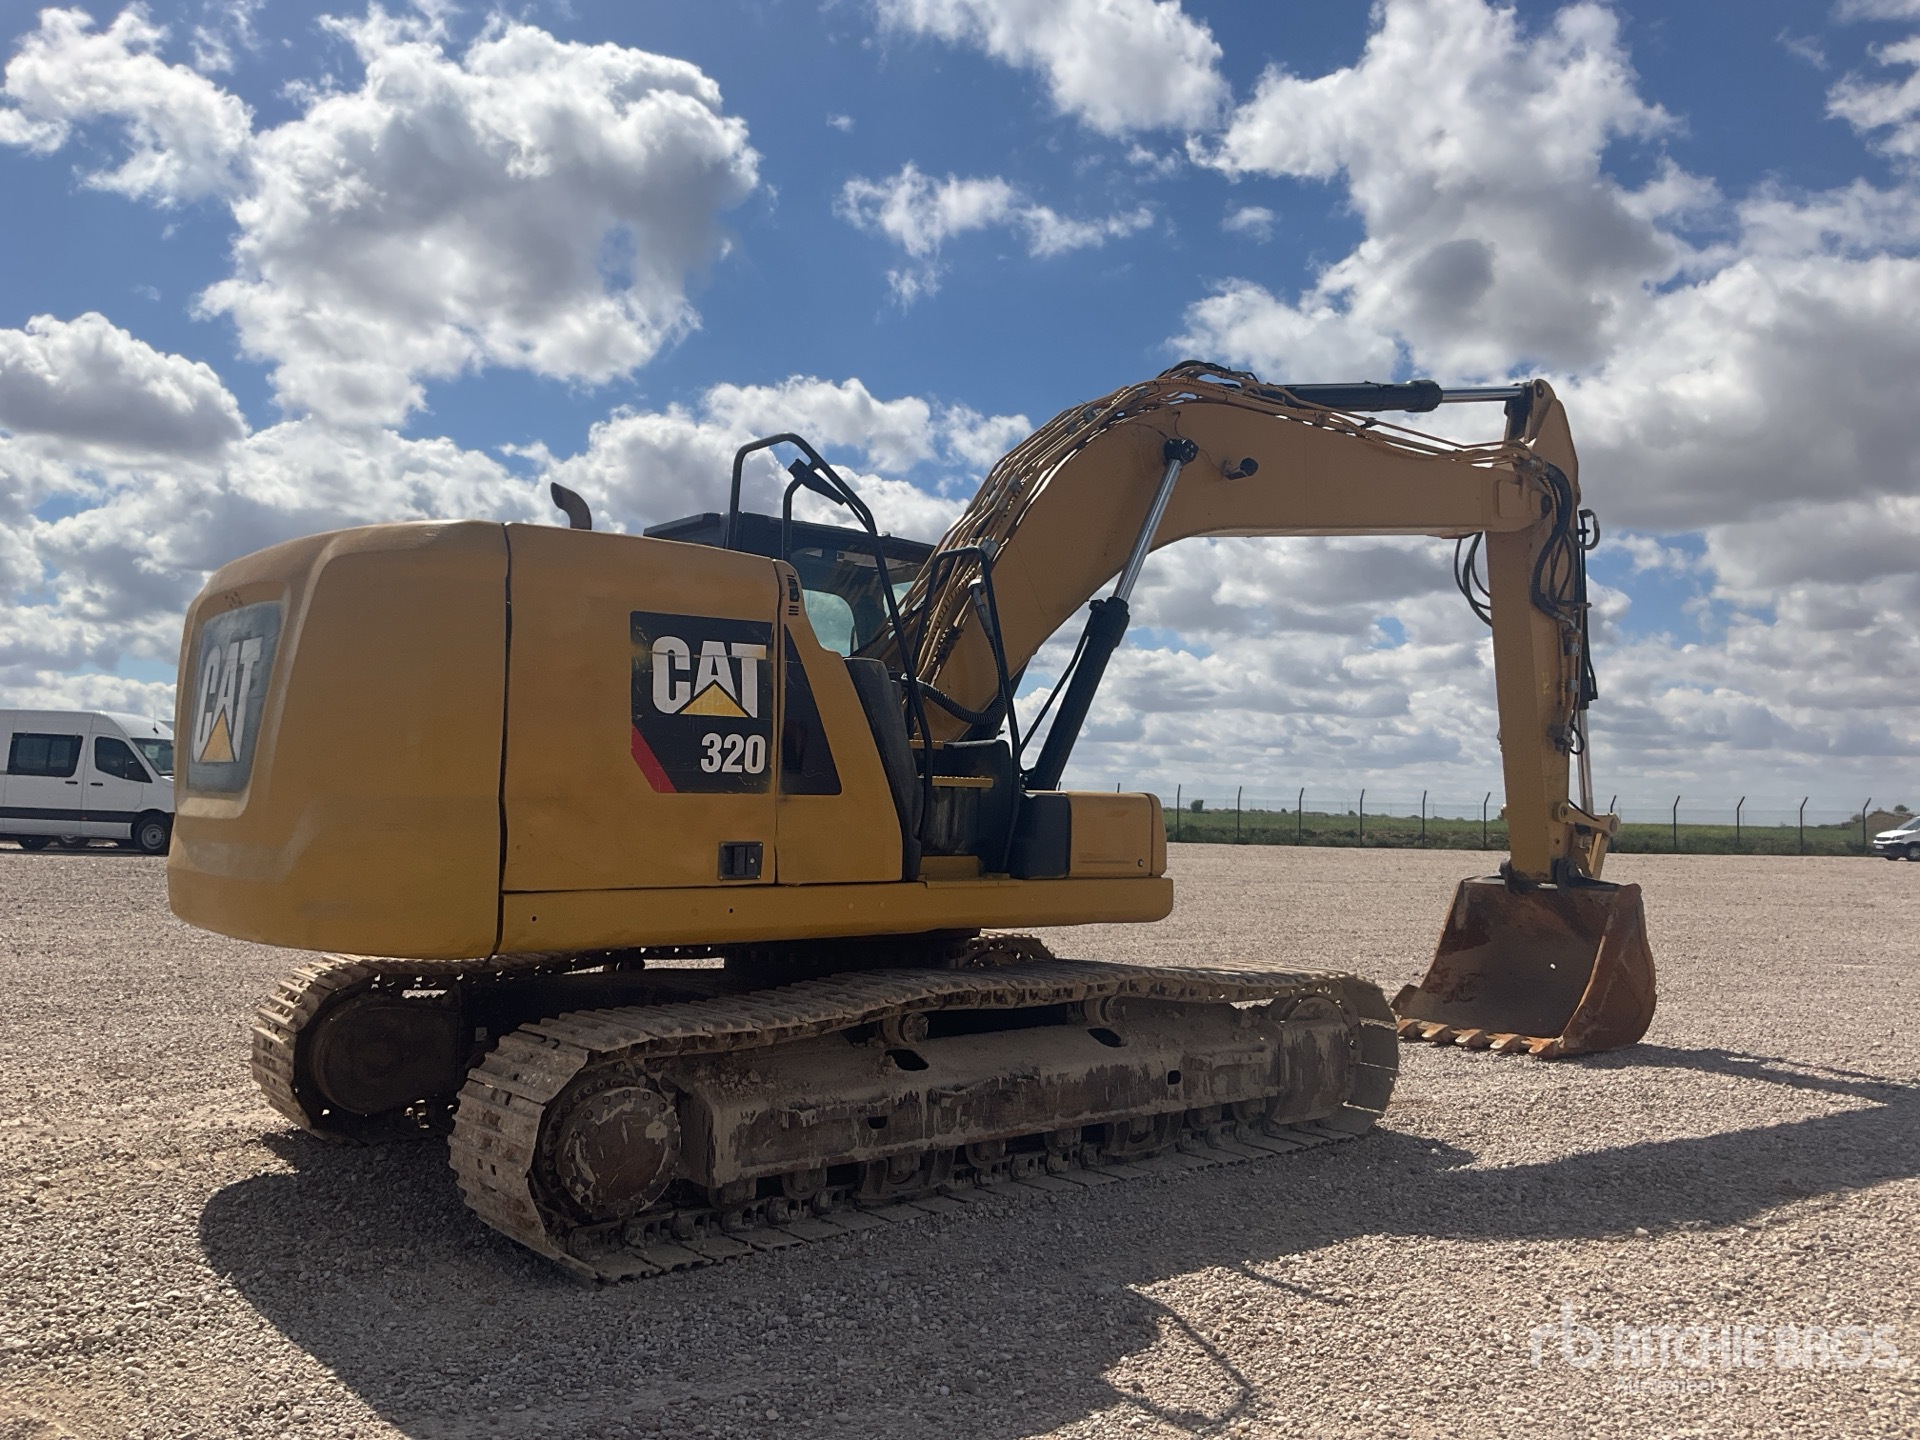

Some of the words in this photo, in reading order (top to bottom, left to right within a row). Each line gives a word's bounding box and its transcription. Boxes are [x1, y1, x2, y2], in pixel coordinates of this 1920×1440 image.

[192, 636, 263, 763] CAT
[652, 635, 767, 718] CAT
[700, 732, 767, 774] 320
